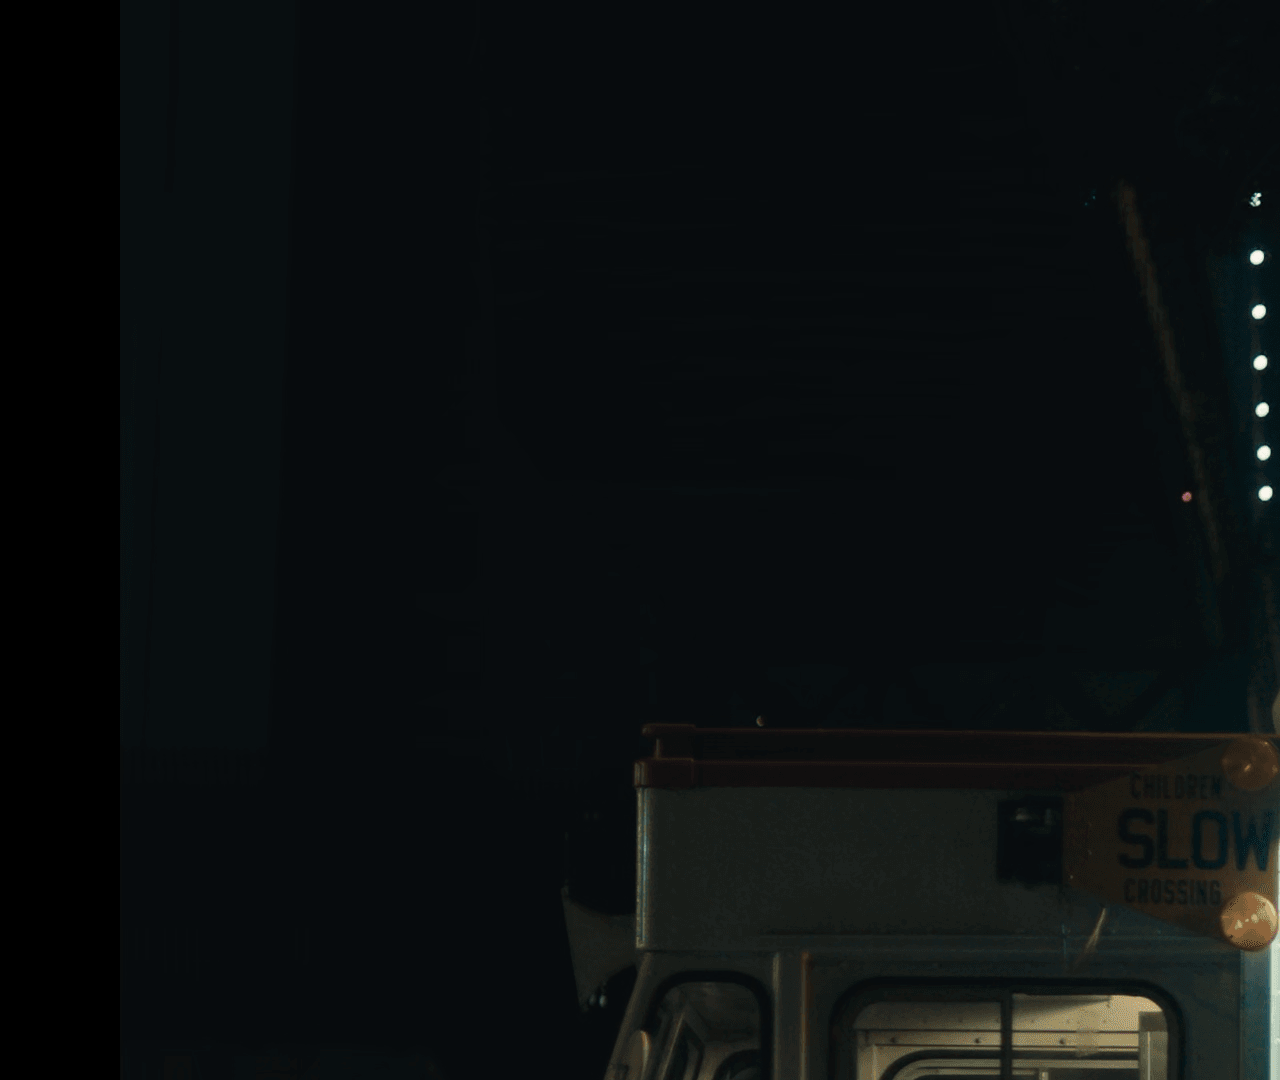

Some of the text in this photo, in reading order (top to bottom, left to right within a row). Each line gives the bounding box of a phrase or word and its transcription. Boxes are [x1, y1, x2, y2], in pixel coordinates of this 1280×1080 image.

[1130, 773, 1223, 800] CHILDREN
[1117, 807, 1275, 871] SLOW
[1123, 877, 1223, 907] CROSSING
